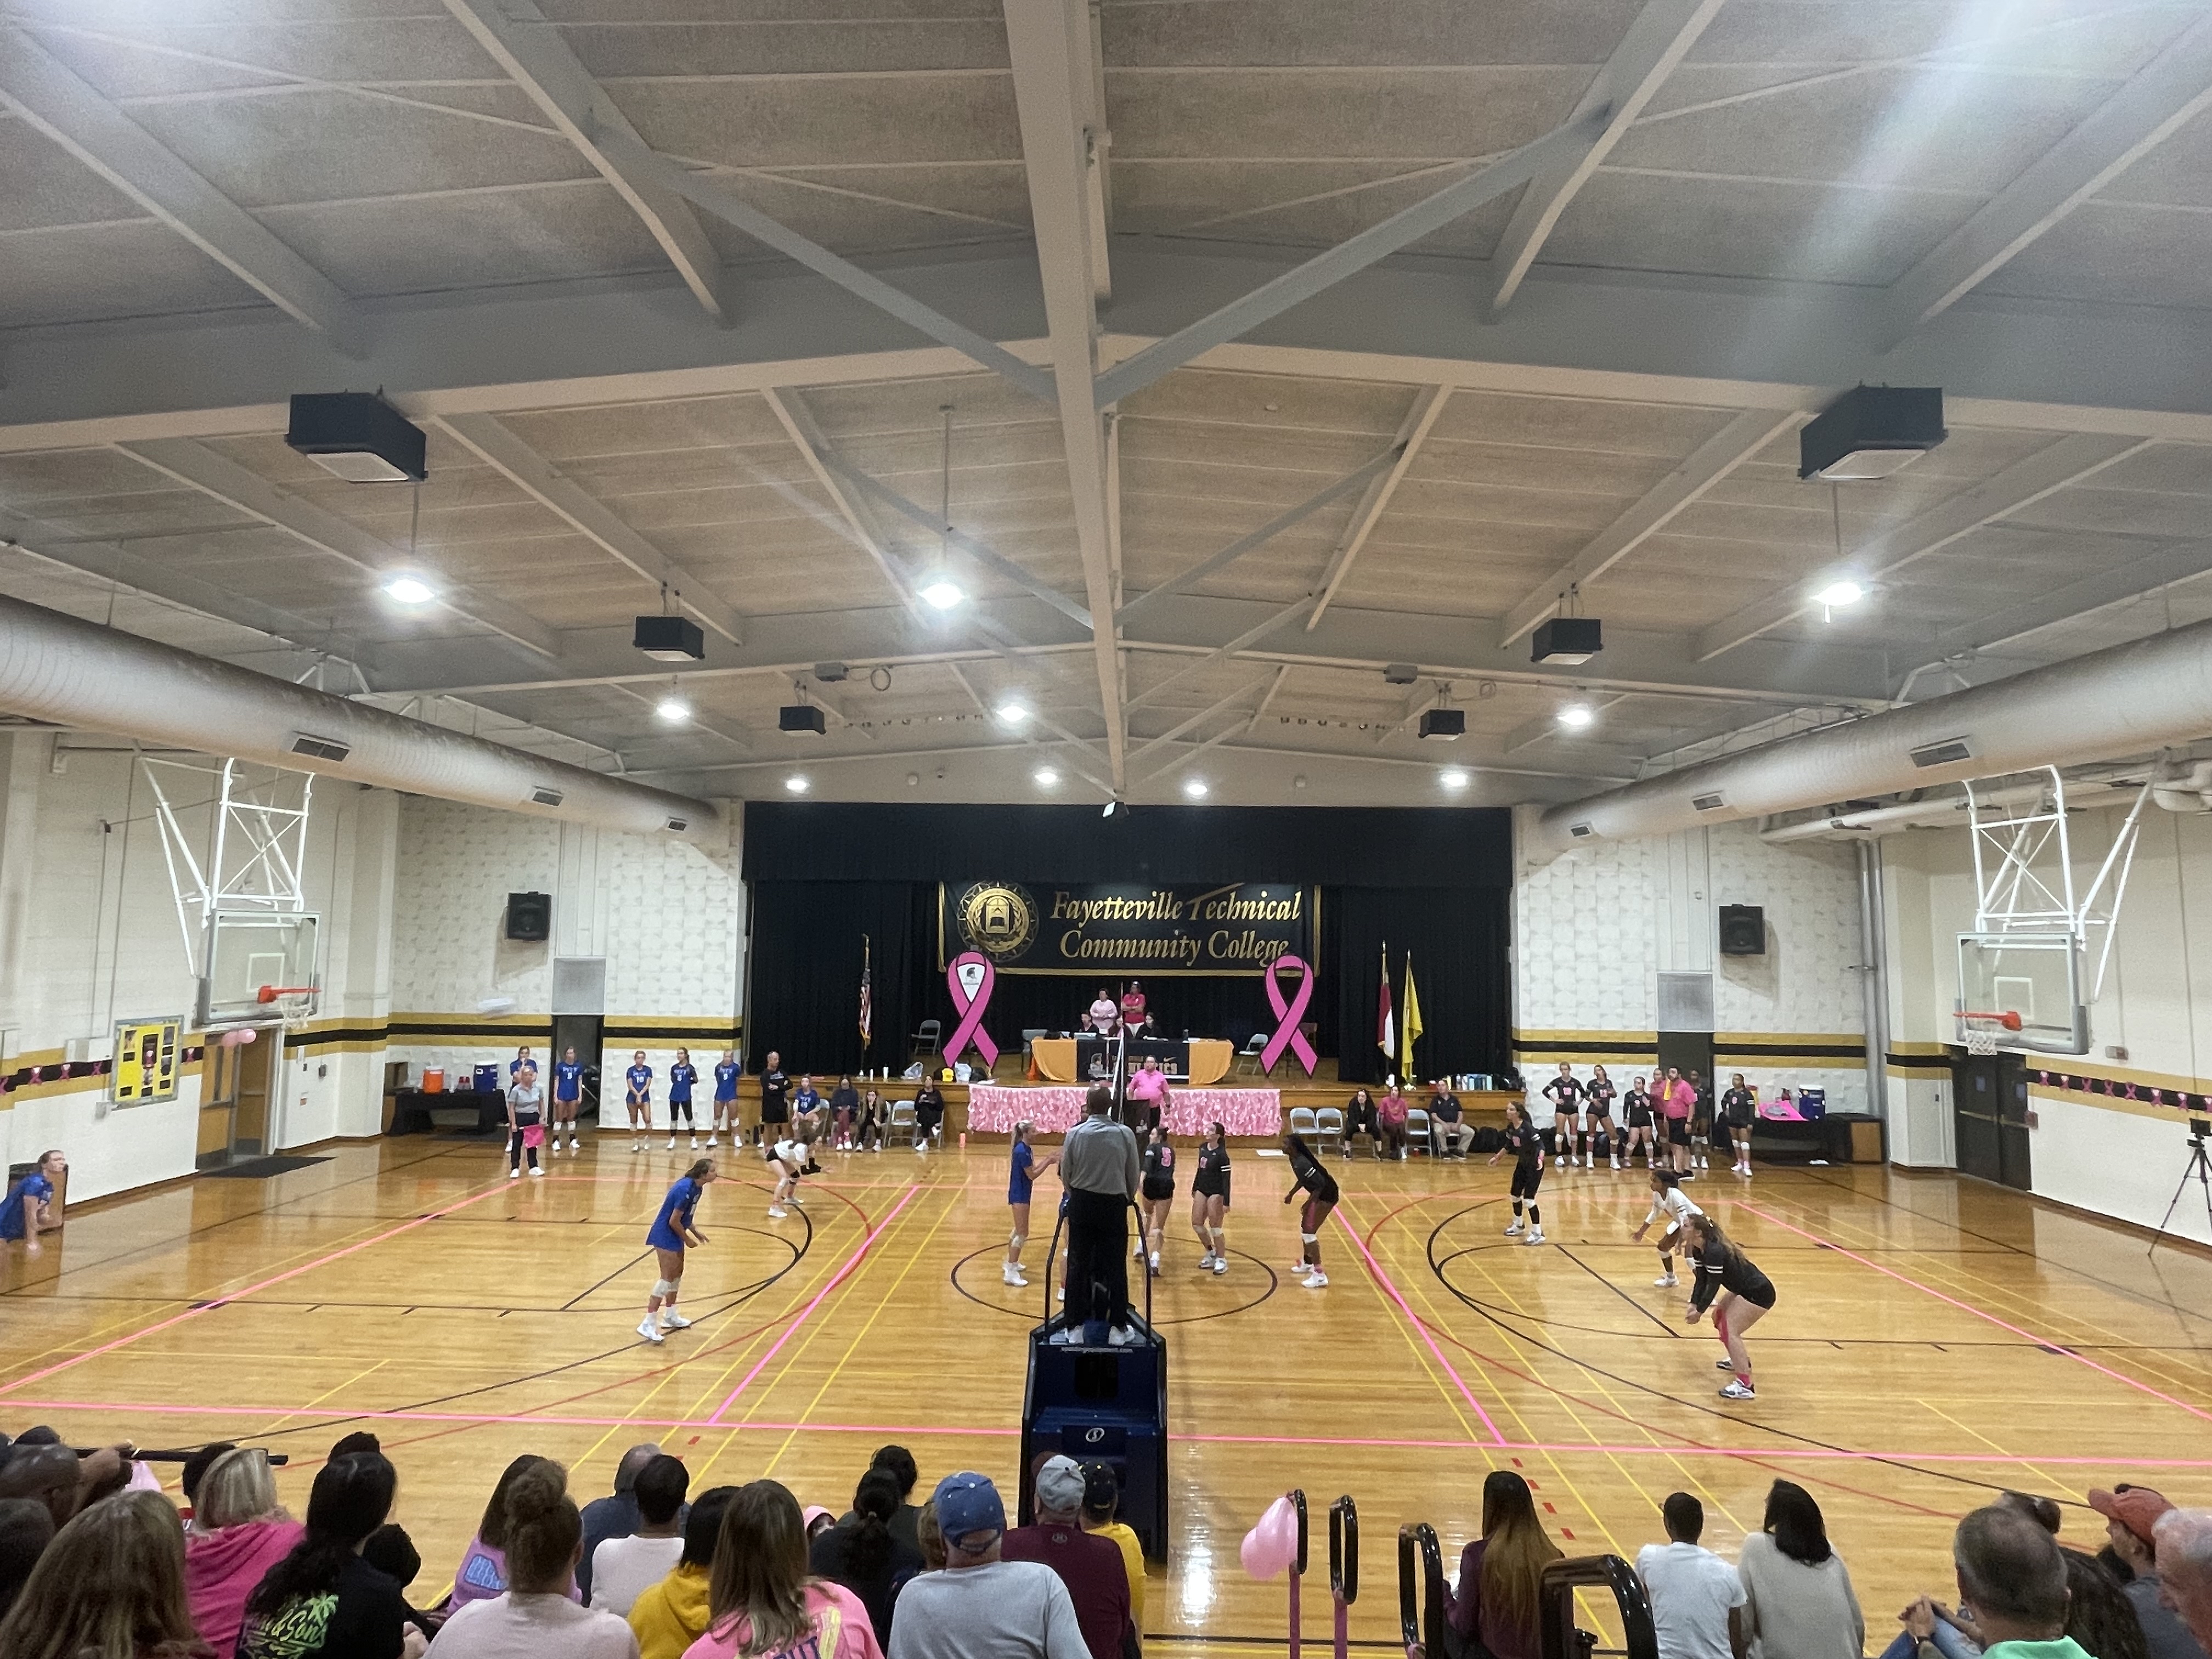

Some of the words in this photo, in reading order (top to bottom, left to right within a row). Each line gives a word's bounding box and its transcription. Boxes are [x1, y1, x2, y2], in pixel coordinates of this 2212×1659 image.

[1049, 890, 1183, 928] Fayetteville
[1186, 882, 1302, 921] Technical
[1060, 929, 1203, 967] Community
[1208, 929, 1289, 968] College
[1161, 1147, 1172, 1167] 5
